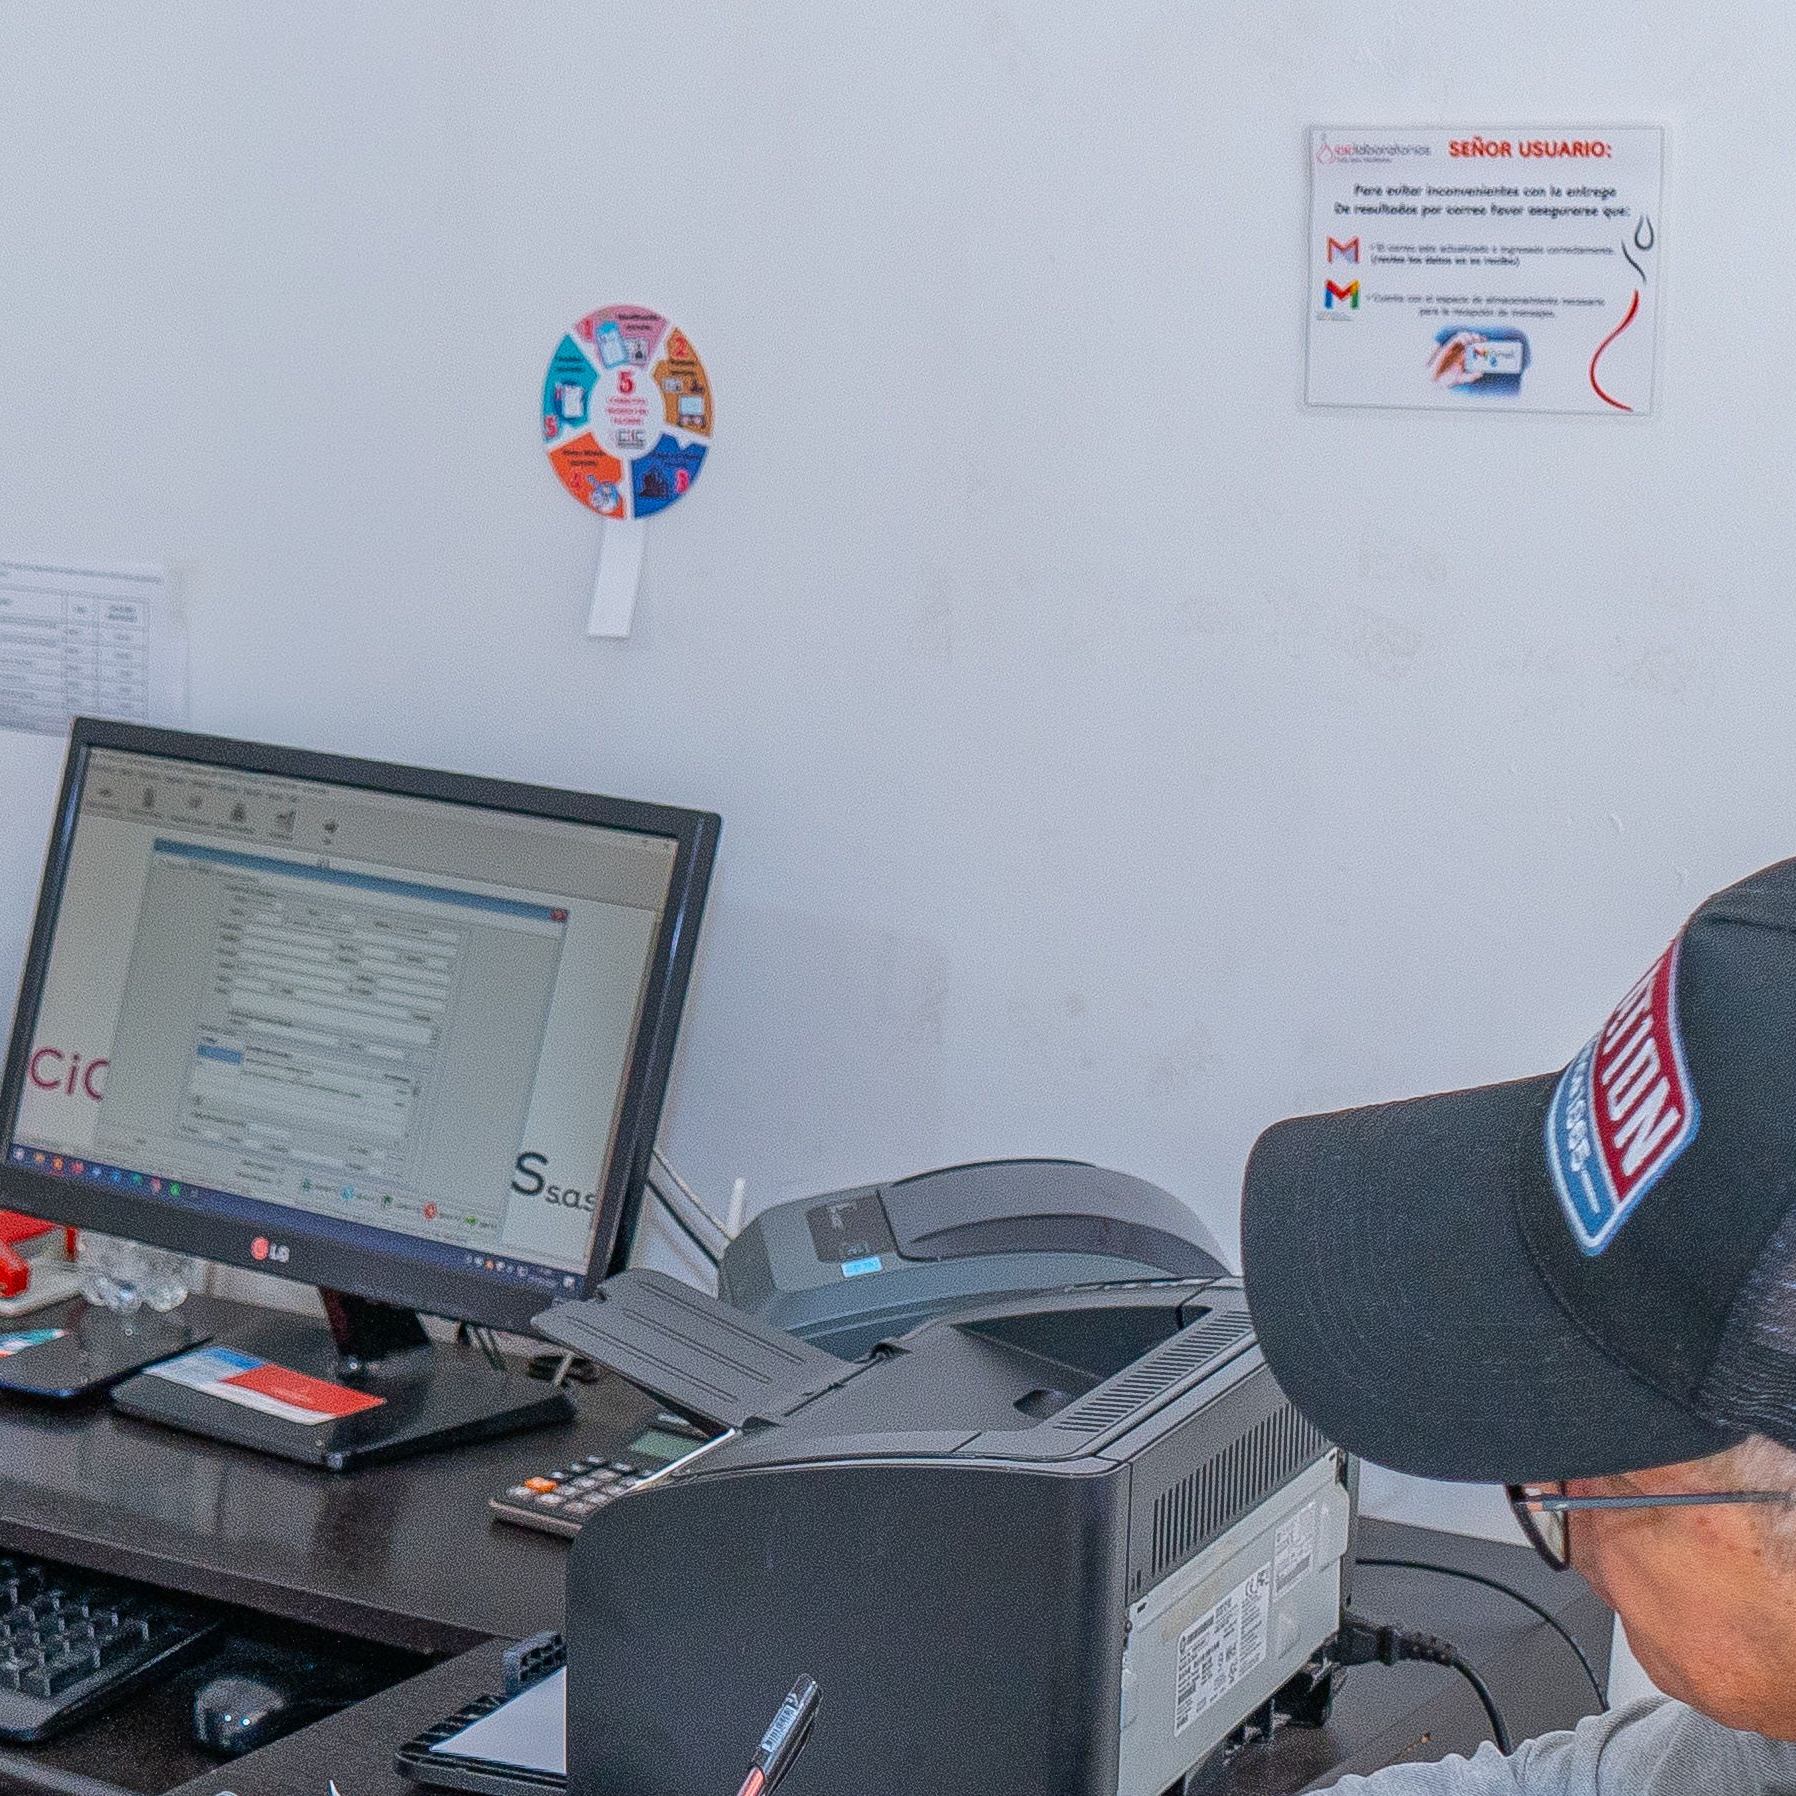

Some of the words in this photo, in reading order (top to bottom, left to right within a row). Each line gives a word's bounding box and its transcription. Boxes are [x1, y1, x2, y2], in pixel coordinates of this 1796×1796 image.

[1448, 136, 1512, 158] SEÑOR
[1518, 140, 1613, 158] USUARIO:
[619, 371, 635, 393] 5
